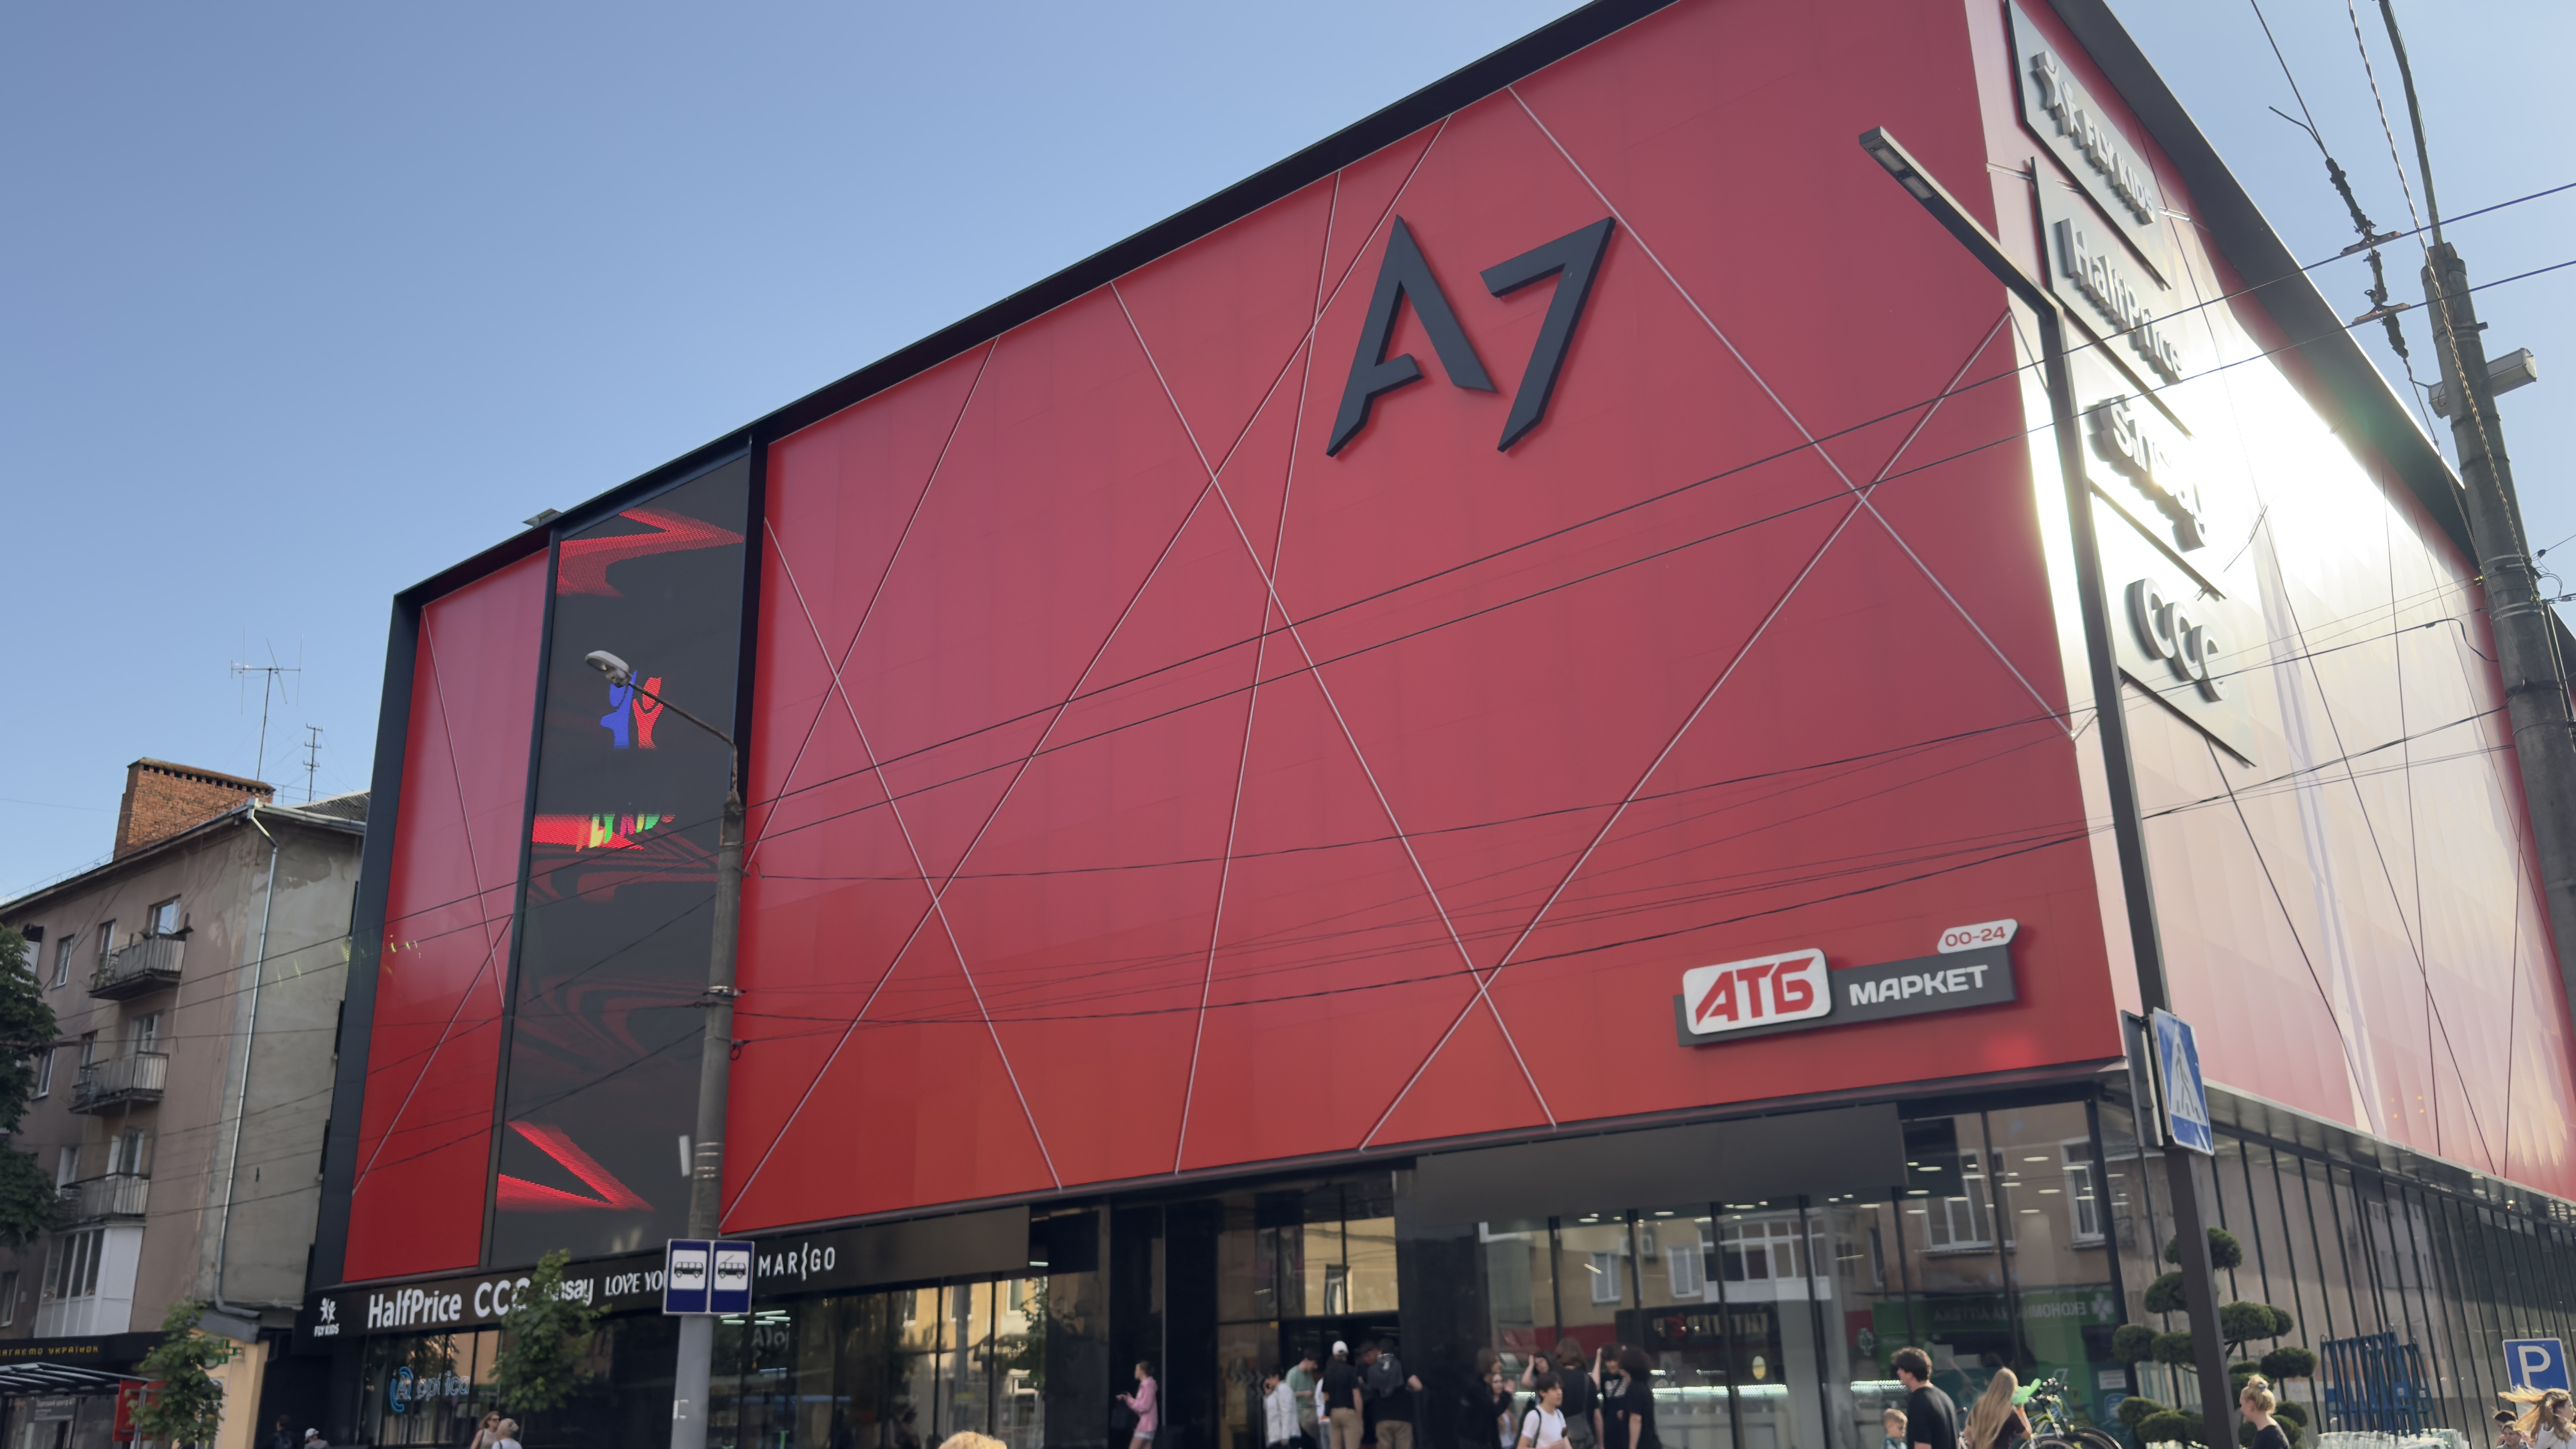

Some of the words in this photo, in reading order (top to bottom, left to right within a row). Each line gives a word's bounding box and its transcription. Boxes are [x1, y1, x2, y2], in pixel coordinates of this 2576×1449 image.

[2078, 108, 2115, 175] FLY
[2111, 152, 2155, 225] KIDS
[1326, 214, 1617, 458] A7
[2134, 577, 2229, 702] CCC
[1695, 956, 1815, 1026] АТБ
[1849, 965, 1988, 1006] МАРКЕТ
[474, 1277, 531, 1318] CCC
[544, 1278, 594, 1307] say
[605, 1272, 641, 1296] LOVE
[367, 1288, 462, 1329] HalfPrice
[0, 1348, 43, 1357] ЯГАЄМО
[2517, 1345, 2551, 1388] P
